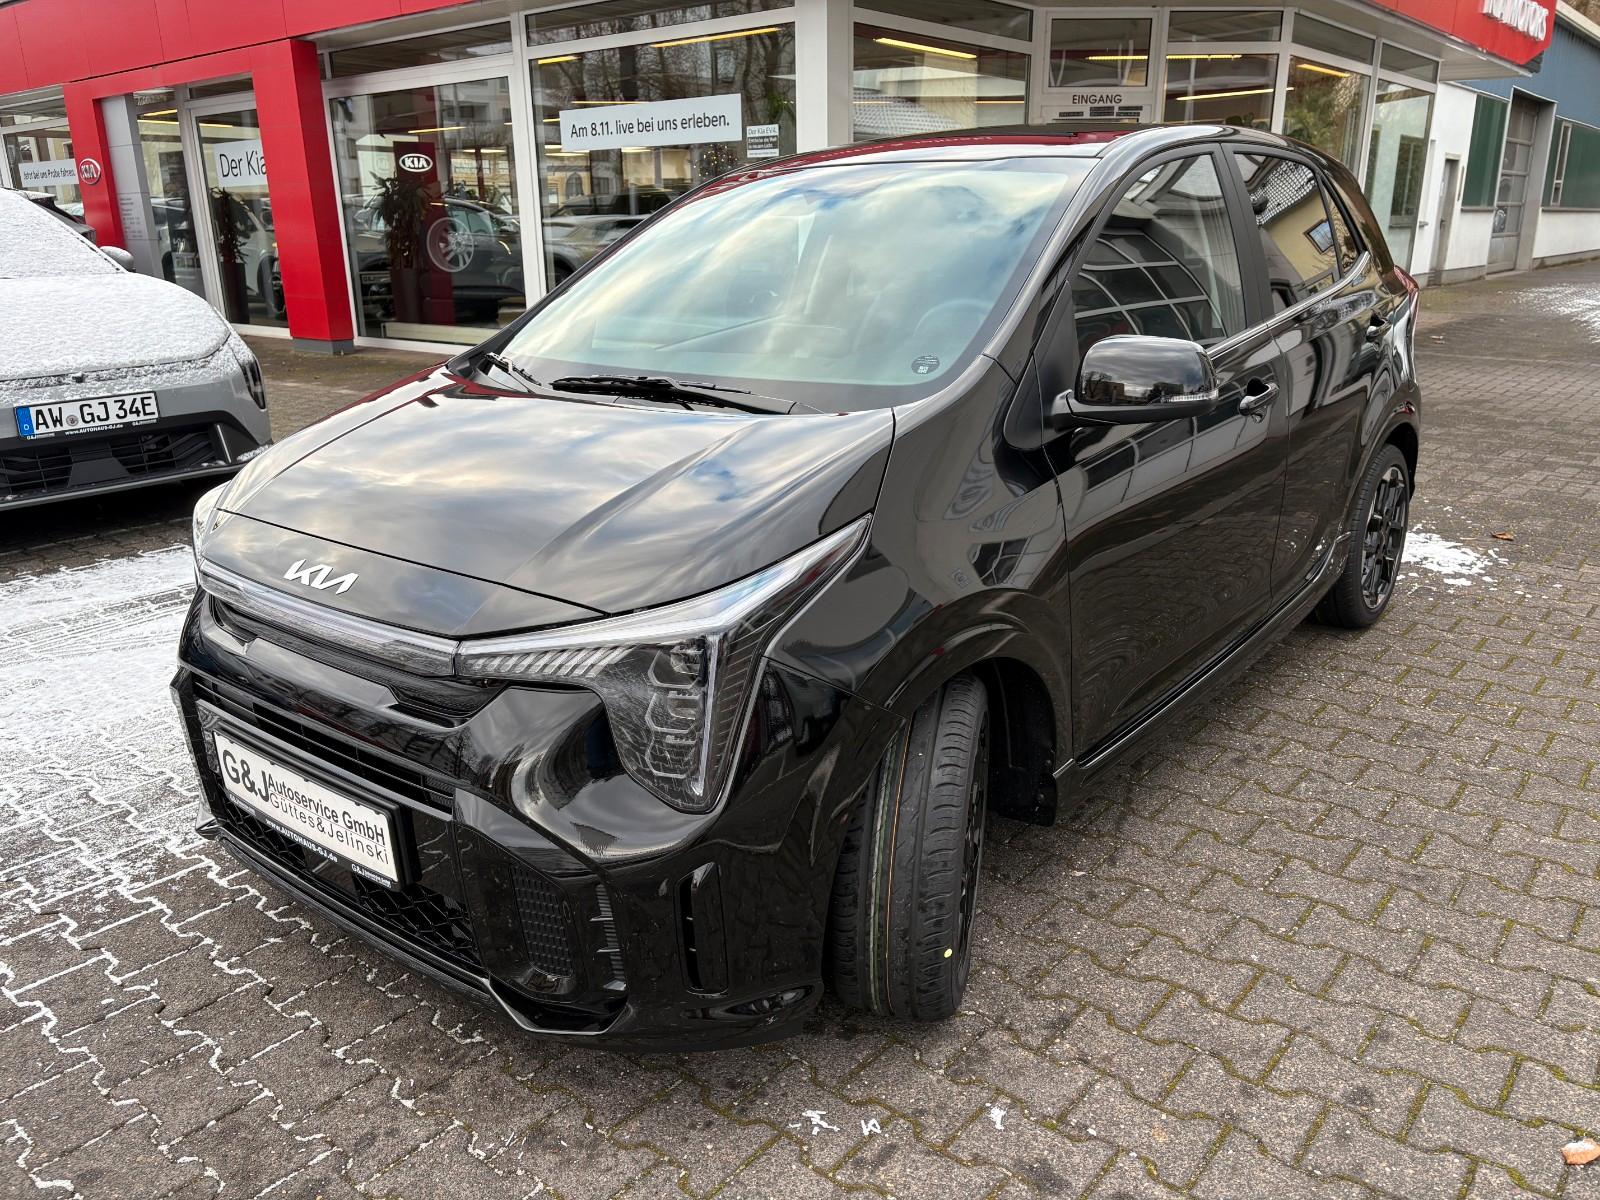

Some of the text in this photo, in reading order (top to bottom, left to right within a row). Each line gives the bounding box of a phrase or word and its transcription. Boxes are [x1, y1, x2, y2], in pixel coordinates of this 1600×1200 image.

[1072, 94, 1122, 104] EINGANG
[571, 112, 730, 138] Am 8.11. live bei uns erleben.
[81, 164, 97, 178] KIA
[219, 150, 267, 177] Der Kia
[404, 157, 428, 168] KIA
[35, 396, 156, 431] AW GJ 34E
[65, 424, 124, 436] www.AUTOHAUS-GJ.de
[283, 559, 359, 595] KIA
[222, 750, 270, 803] G&J
[268, 773, 386, 845] Autoservice GmbH
[265, 818, 338, 863] www.AUTOHAUS-GJ.de
